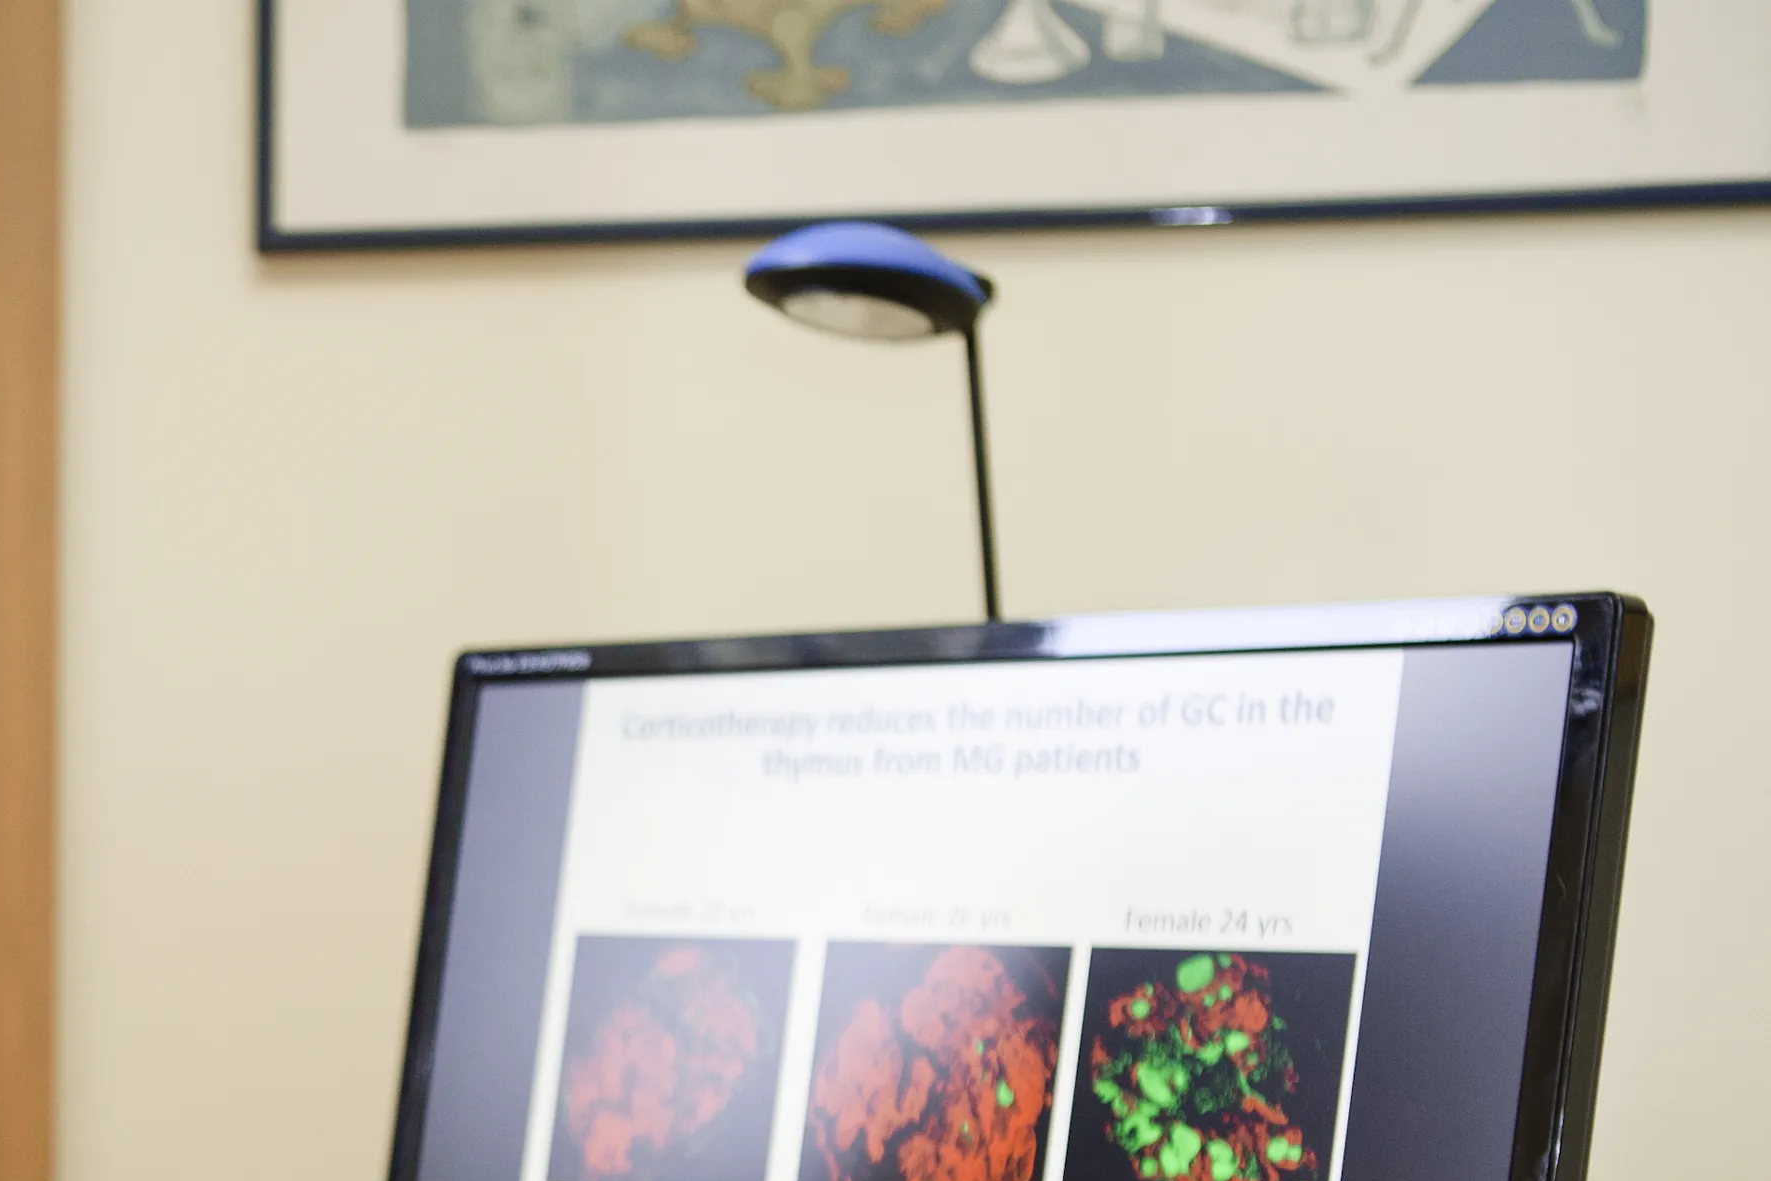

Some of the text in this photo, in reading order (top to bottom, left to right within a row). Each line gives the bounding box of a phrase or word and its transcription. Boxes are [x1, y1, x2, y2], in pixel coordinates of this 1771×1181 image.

[828, 704, 936, 735] reduces
[946, 702, 995, 731] the
[1004, 697, 1125, 729] number
[1138, 692, 1171, 727] of
[1180, 693, 1228, 727] GC
[1236, 691, 1268, 725] in
[1278, 690, 1335, 725] the
[763, 742, 1141, 783] thymus from MG patients
[1125, 906, 1293, 942] Female 24 yrs
